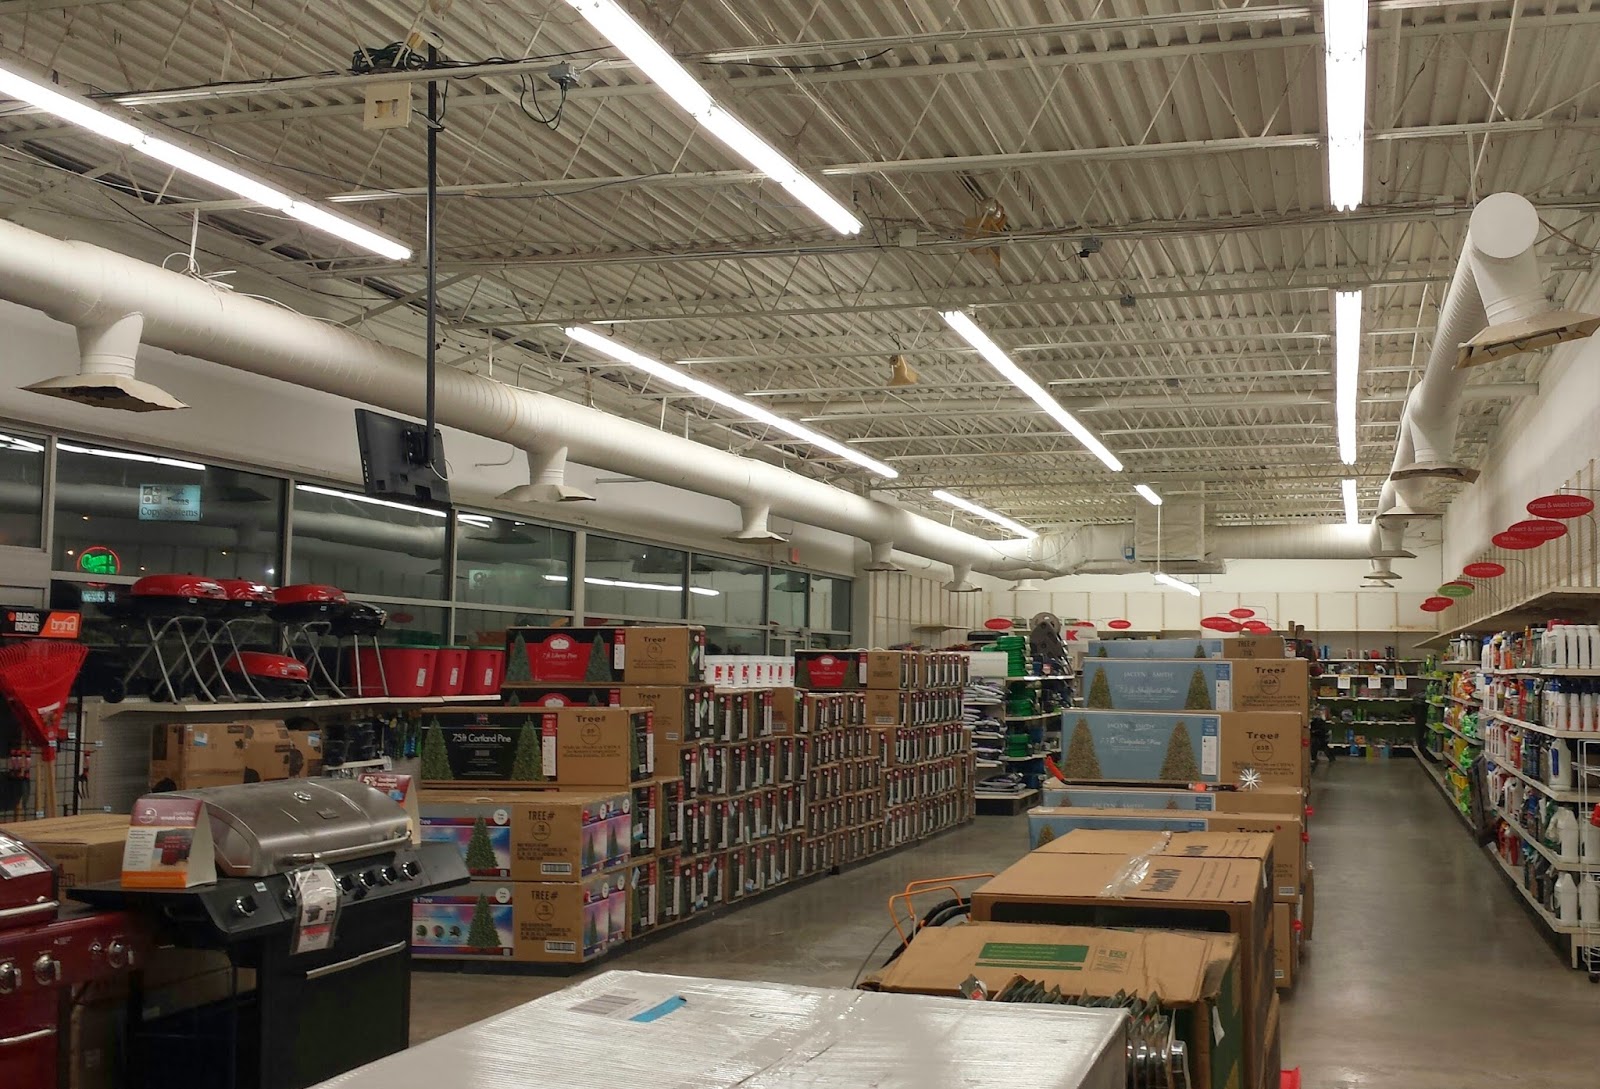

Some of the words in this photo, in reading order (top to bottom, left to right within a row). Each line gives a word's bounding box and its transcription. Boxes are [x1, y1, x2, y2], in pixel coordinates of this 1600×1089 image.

[15, 622, 39, 633] DECKER
[51, 616, 77, 631] bond
[1066, 630, 1079, 641] K
[468, 733, 497, 743] Cortland
[497, 733, 512, 743] Pine
[528, 810, 547, 820] TREE
[531, 890, 550, 900] TREE
